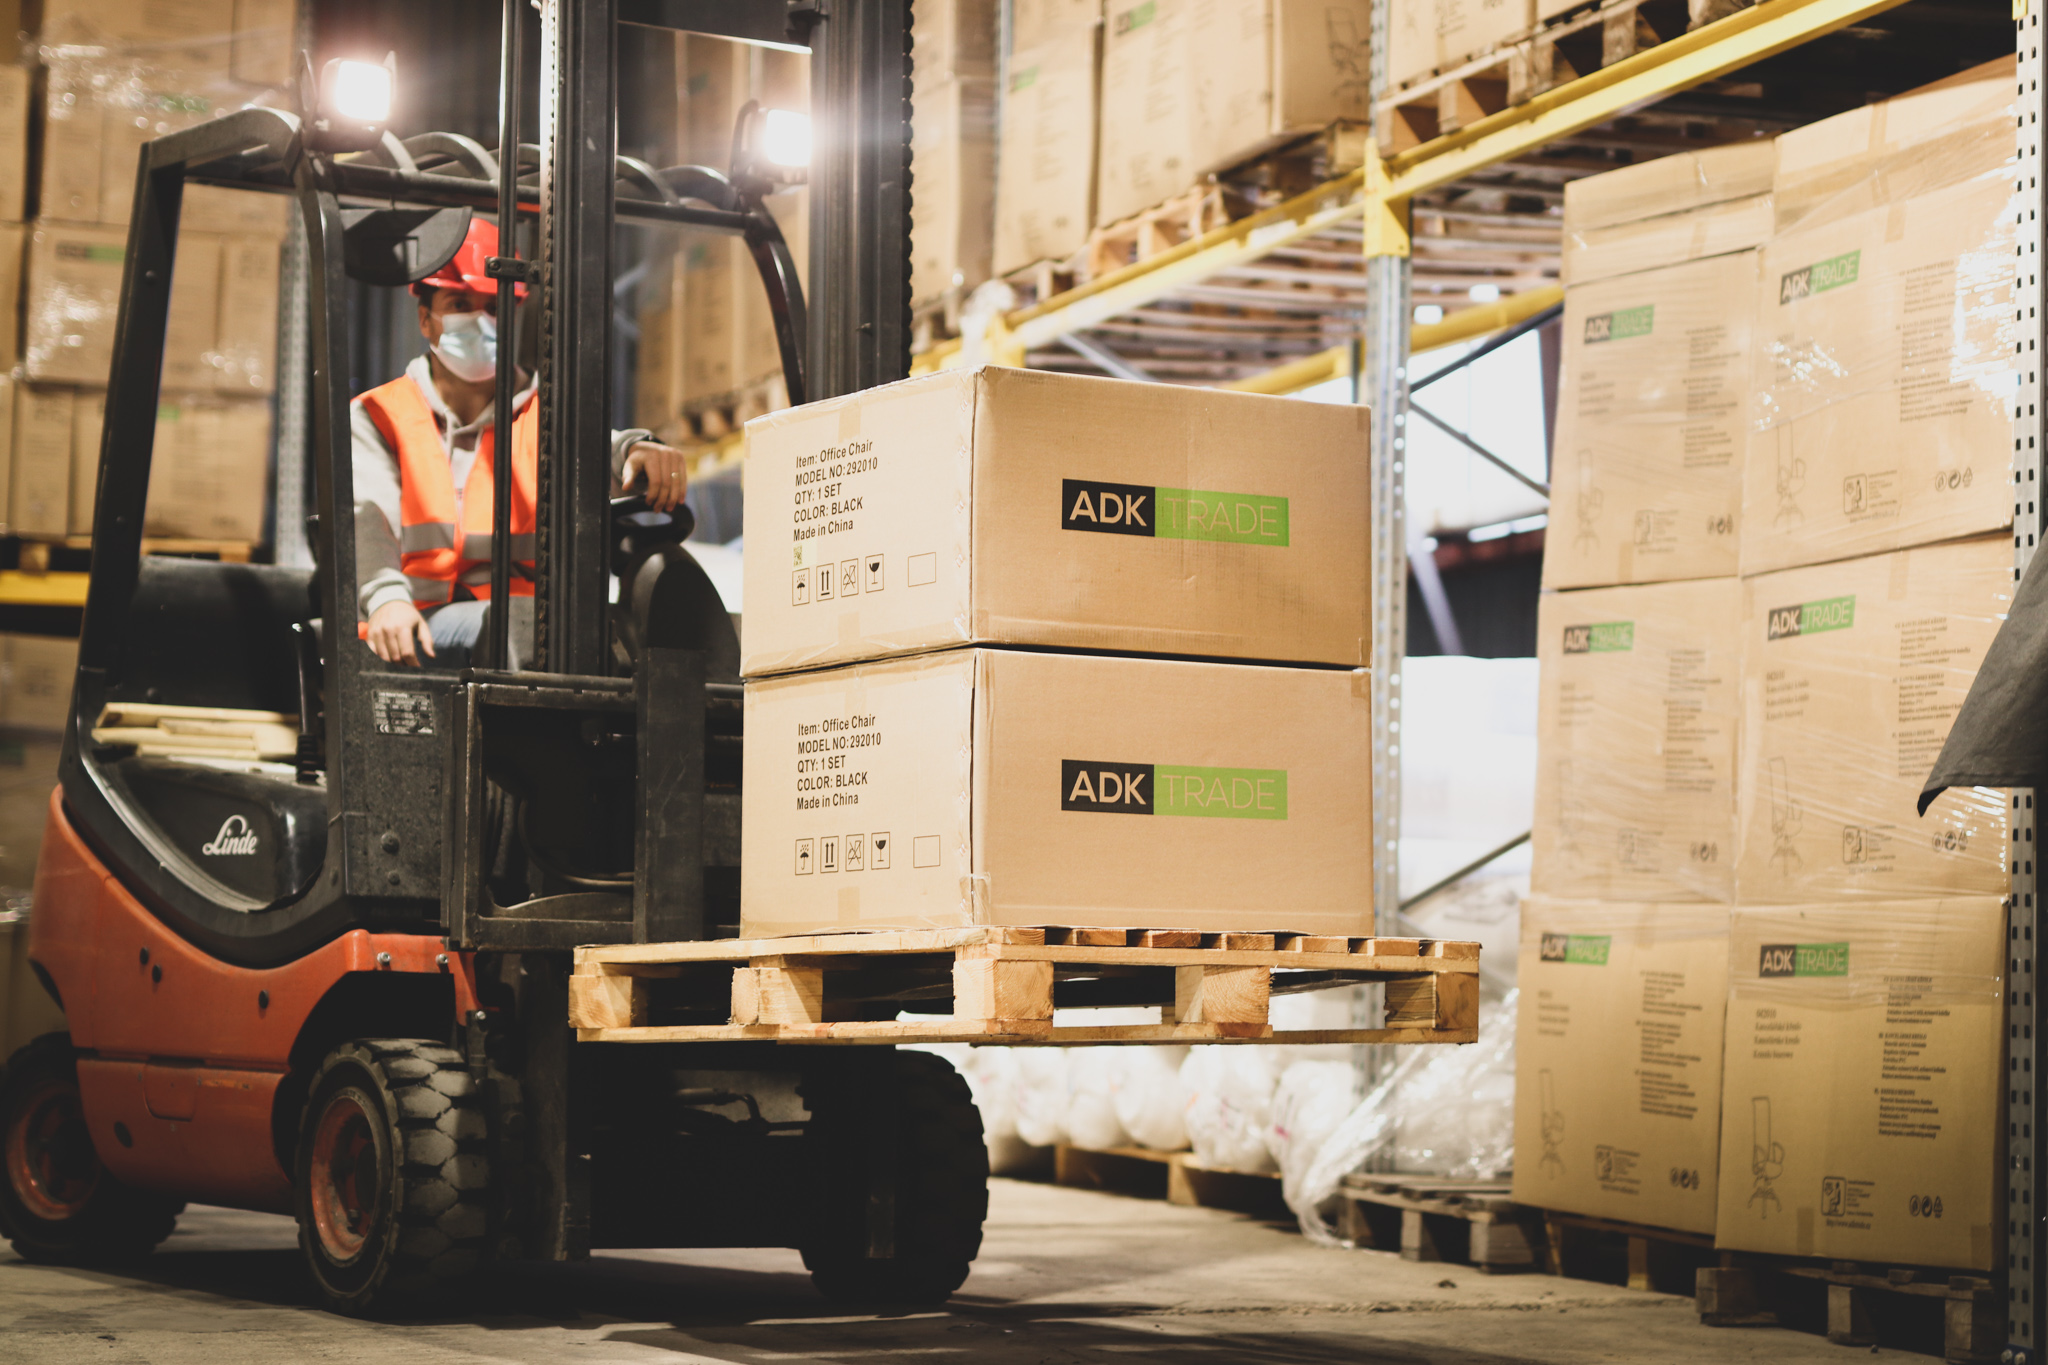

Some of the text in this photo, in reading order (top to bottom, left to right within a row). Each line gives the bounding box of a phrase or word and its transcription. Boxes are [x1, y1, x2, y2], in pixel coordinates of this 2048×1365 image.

[1782, 271, 1810, 303] ADK
[1813, 254, 1858, 290] TRADE
[796, 439, 873, 469] Item: Office Chair
[795, 468, 827, 487] MODEL
[794, 482, 842, 505] QTY: 1 SET
[793, 496, 863, 523] COLOR: BLACK
[1069, 490, 1279, 537] ADK TRADE
[793, 519, 854, 541] Made in China
[1769, 600, 1851, 637] ADK TRADE
[798, 713, 876, 736] Item: Office Chair
[798, 738, 830, 755] MODEL
[797, 755, 846, 773] QTY: 1 SET
[797, 771, 868, 791] COLOR: BLACK
[1068, 770, 1276, 810] ADK TRADE
[797, 792, 859, 810] Made in China
[202, 814, 257, 855] Linde
[1761, 946, 1845, 974] ADK TRADE
